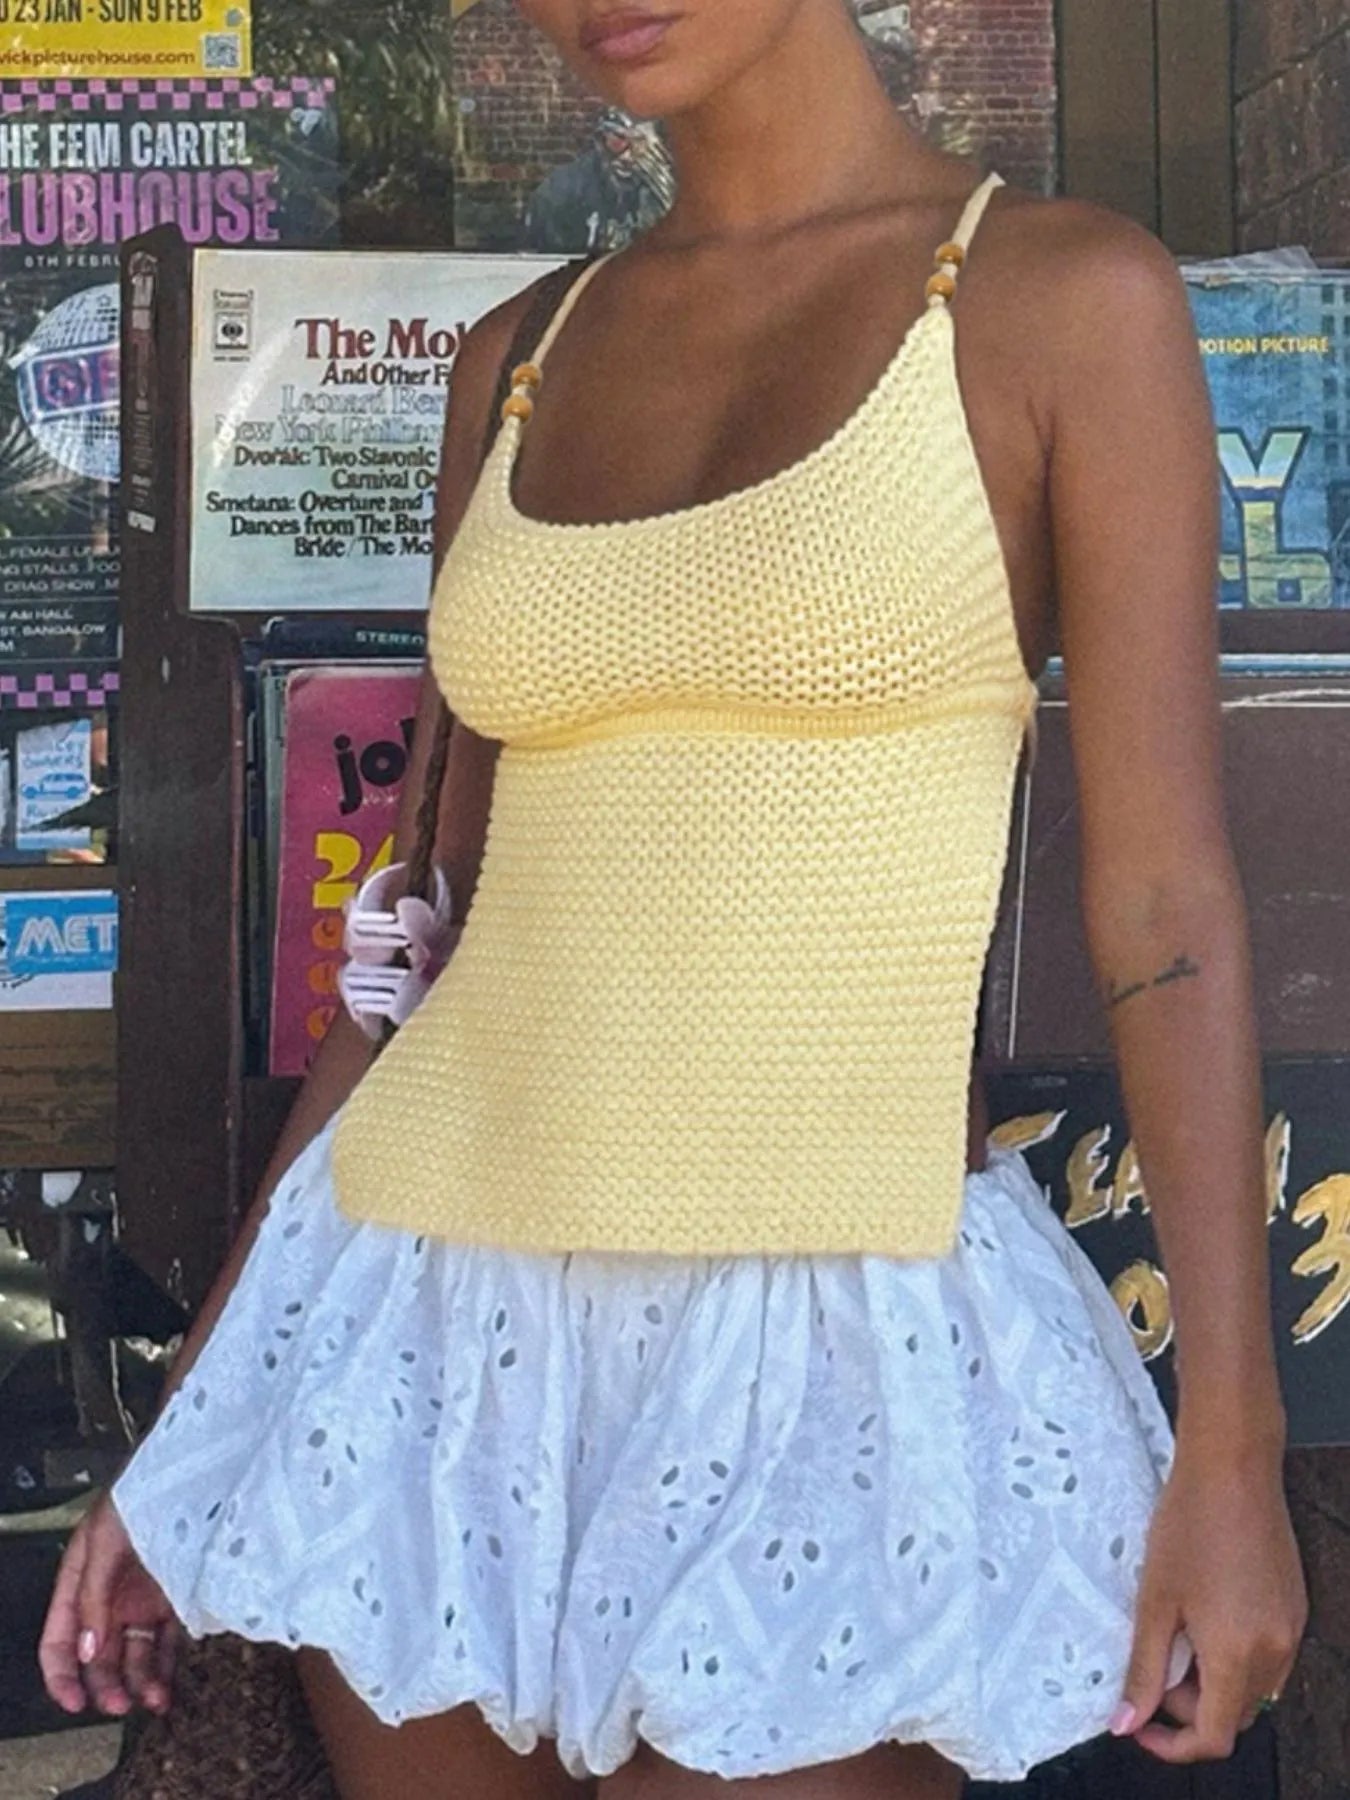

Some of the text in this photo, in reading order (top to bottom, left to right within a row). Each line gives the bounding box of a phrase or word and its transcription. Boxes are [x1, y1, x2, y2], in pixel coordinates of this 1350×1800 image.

[15, 0, 39, 22] 23
[44, 0, 82, 22] JAN
[98, 0, 142, 22] SUN
[166, 0, 202, 22] FEB
[49, 121, 121, 168] FEM
[130, 121, 252, 167] CARTEL
[0, 170, 280, 246] LUBHOUSE
[294, 317, 375, 359] The
[1261, 335, 1329, 353] PICTURE
[321, 360, 368, 386] And
[371, 361, 431, 386] Other
[281, 384, 387, 415] Leonard
[313, 445, 357, 466] Two
[360, 446, 437, 467] Slavonic
[332, 469, 408, 491] Carnival
[206, 491, 296, 513] Smetana:
[300, 491, 386, 513] Overture
[389, 493, 424, 512] and
[230, 515, 300, 537] Dances
[303, 515, 354, 536] from
[355, 514, 394, 536] The
[294, 537, 346, 558] Bride
[358, 537, 396, 556] The
[4, 580, 48, 593] DRAG
[356, 630, 425, 645] STEREO
[334, 718, 413, 816] jo
[15, 912, 119, 956] MET
